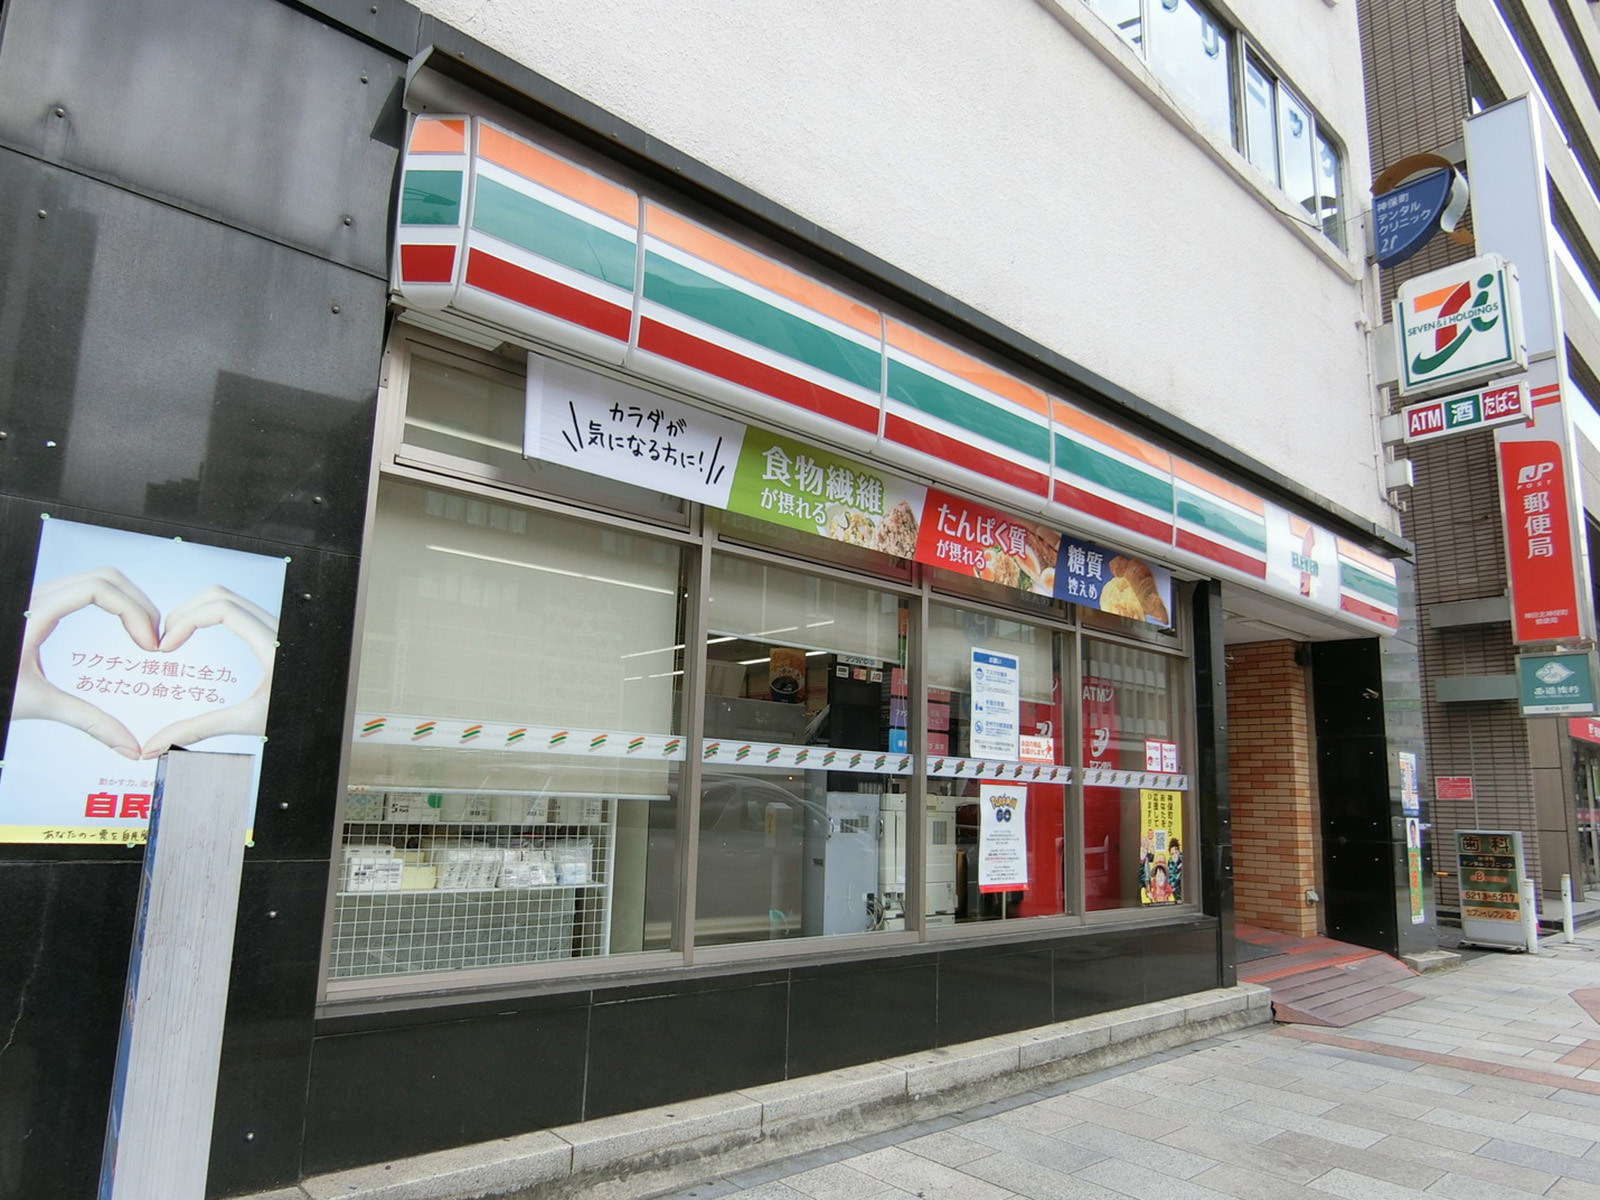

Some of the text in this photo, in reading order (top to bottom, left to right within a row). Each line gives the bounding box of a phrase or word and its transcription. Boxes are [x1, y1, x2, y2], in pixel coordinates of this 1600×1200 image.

[1377, 191, 1410, 212] 神保町
[1379, 208, 1432, 236] クリニック
[1449, 302, 1499, 325] HOLDINGS
[1450, 399, 1475, 425] 酒
[1483, 391, 1520, 416] たばこ
[608, 401, 688, 437] カラダが
[1410, 409, 1442, 433] ATM
[761, 444, 884, 516] 食物繊維
[1516, 479, 1552, 490] POST
[760, 487, 827, 526] が摂れる
[937, 503, 1028, 559] たんぱく質
[1523, 491, 1554, 560] 郵便局
[936, 540, 986, 570] が摂れる
[1067, 544, 1103, 582] 糖質
[1068, 577, 1098, 601] 控えめ
[70, 652, 238, 685] ワクチン接種に全力。
[76, 676, 226, 704] あなたの命を守る。
[990, 793, 1018, 810] Pokémon
[996, 808, 1011, 822] GO
[1462, 835, 1511, 854] 歯科
